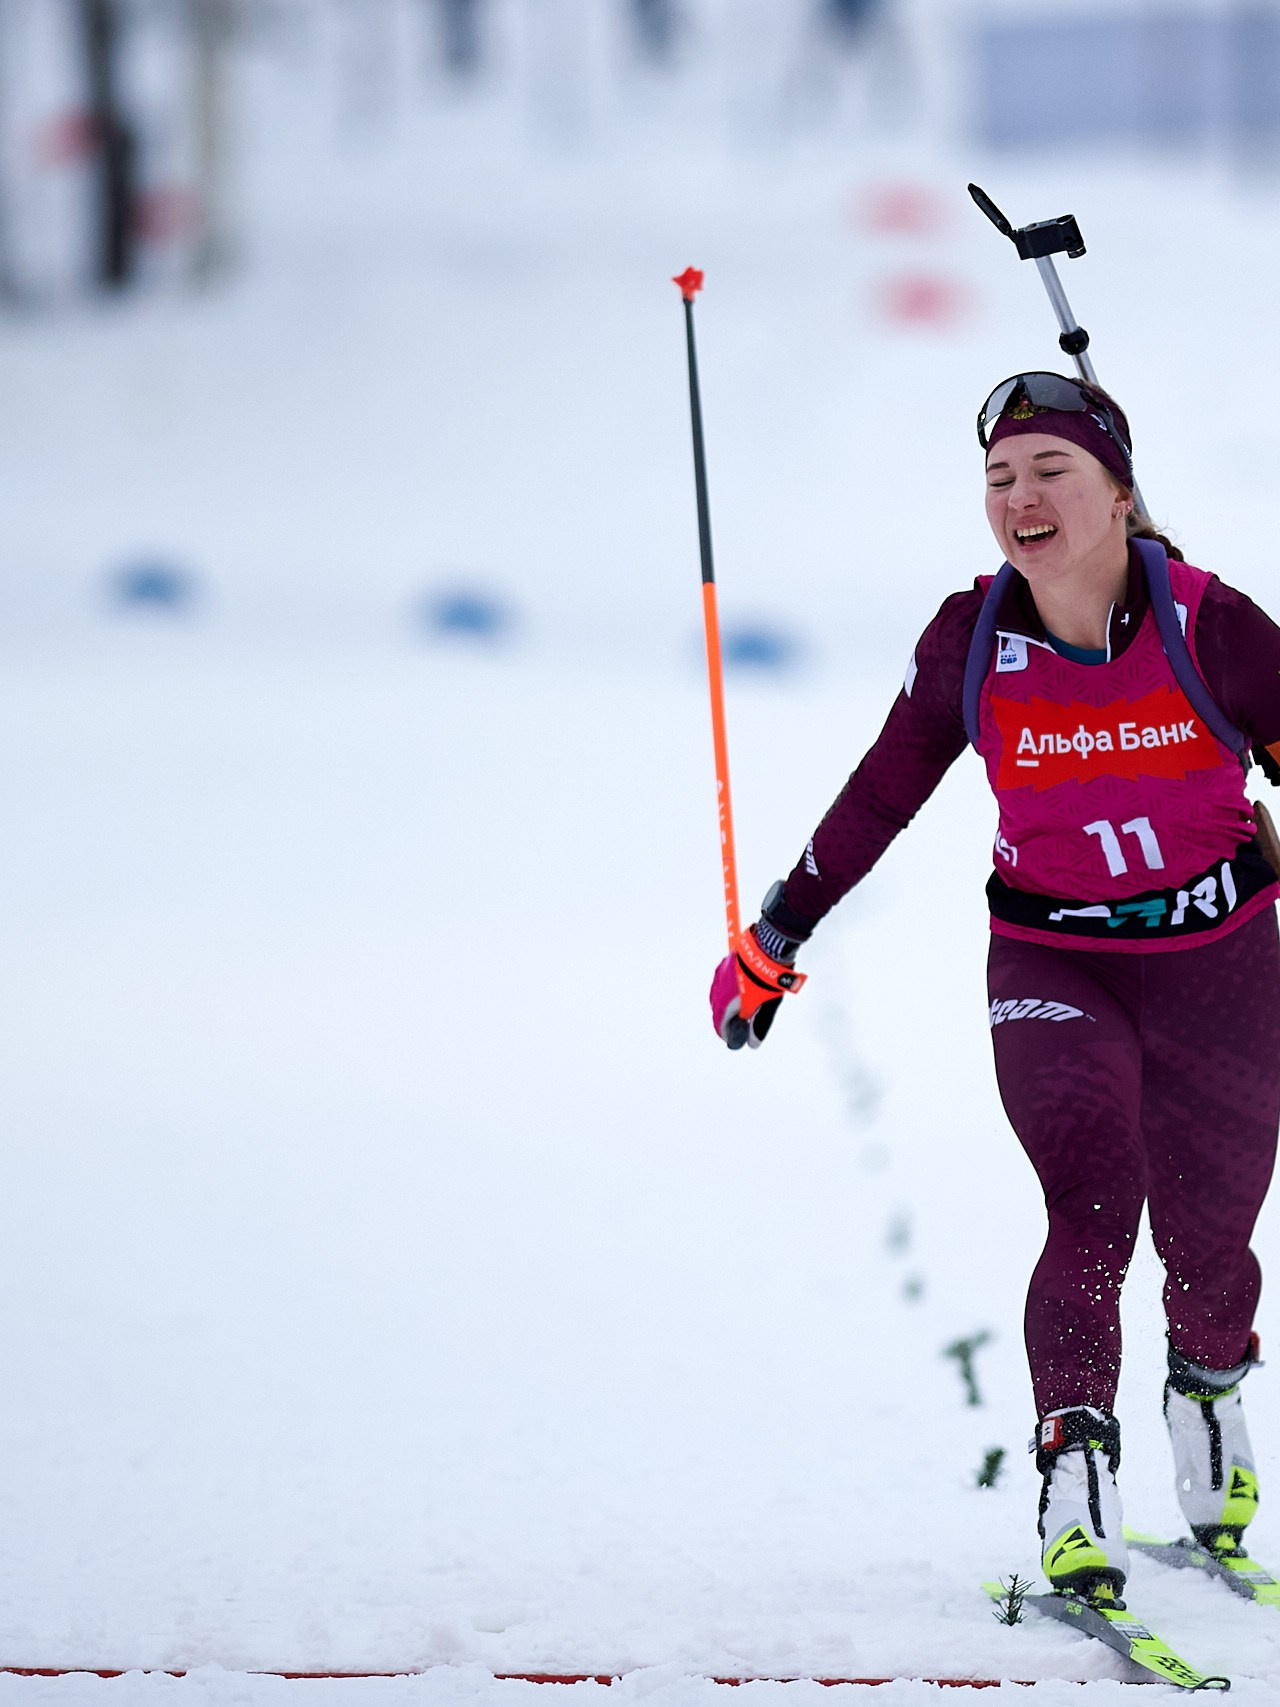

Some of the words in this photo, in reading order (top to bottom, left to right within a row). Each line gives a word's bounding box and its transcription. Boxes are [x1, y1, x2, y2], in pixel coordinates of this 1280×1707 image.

[1017, 725, 1114, 761] Альфа
[1119, 720, 1198, 751] Банк
[1082, 816, 1165, 878] 11
